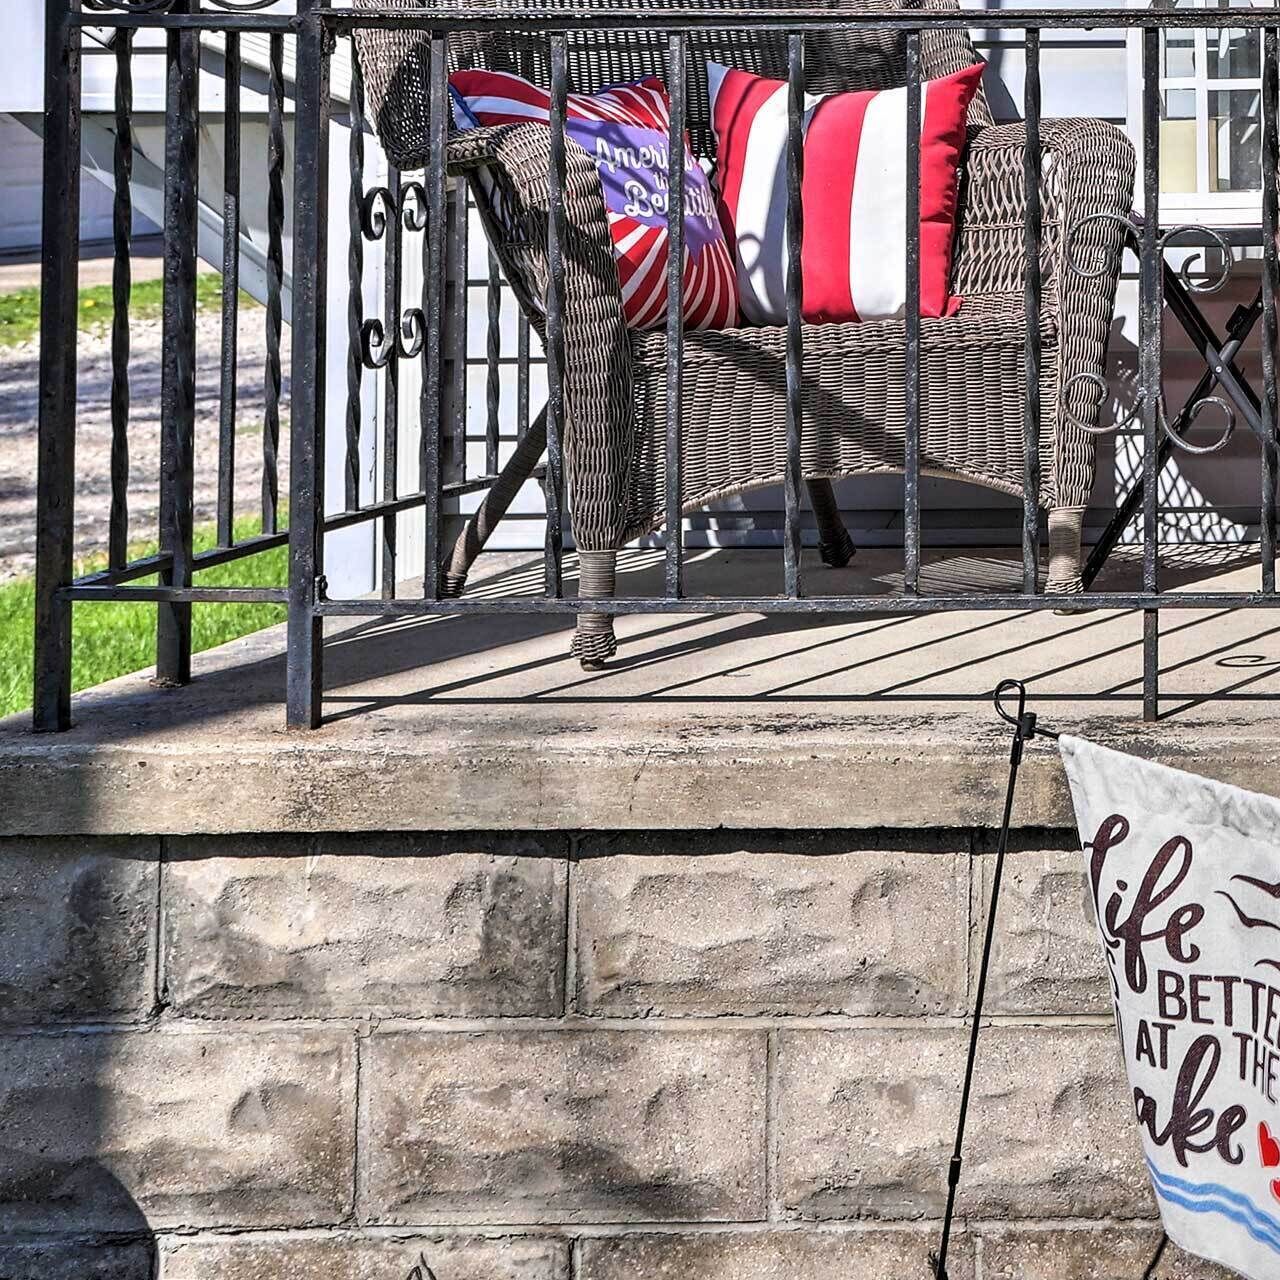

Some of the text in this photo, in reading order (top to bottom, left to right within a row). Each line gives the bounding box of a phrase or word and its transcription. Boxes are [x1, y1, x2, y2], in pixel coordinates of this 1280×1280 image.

[593, 136, 695, 173] Ameri
[1132, 1033, 1248, 1168] ake
[1135, 1018, 1280, 1105] AT THE
